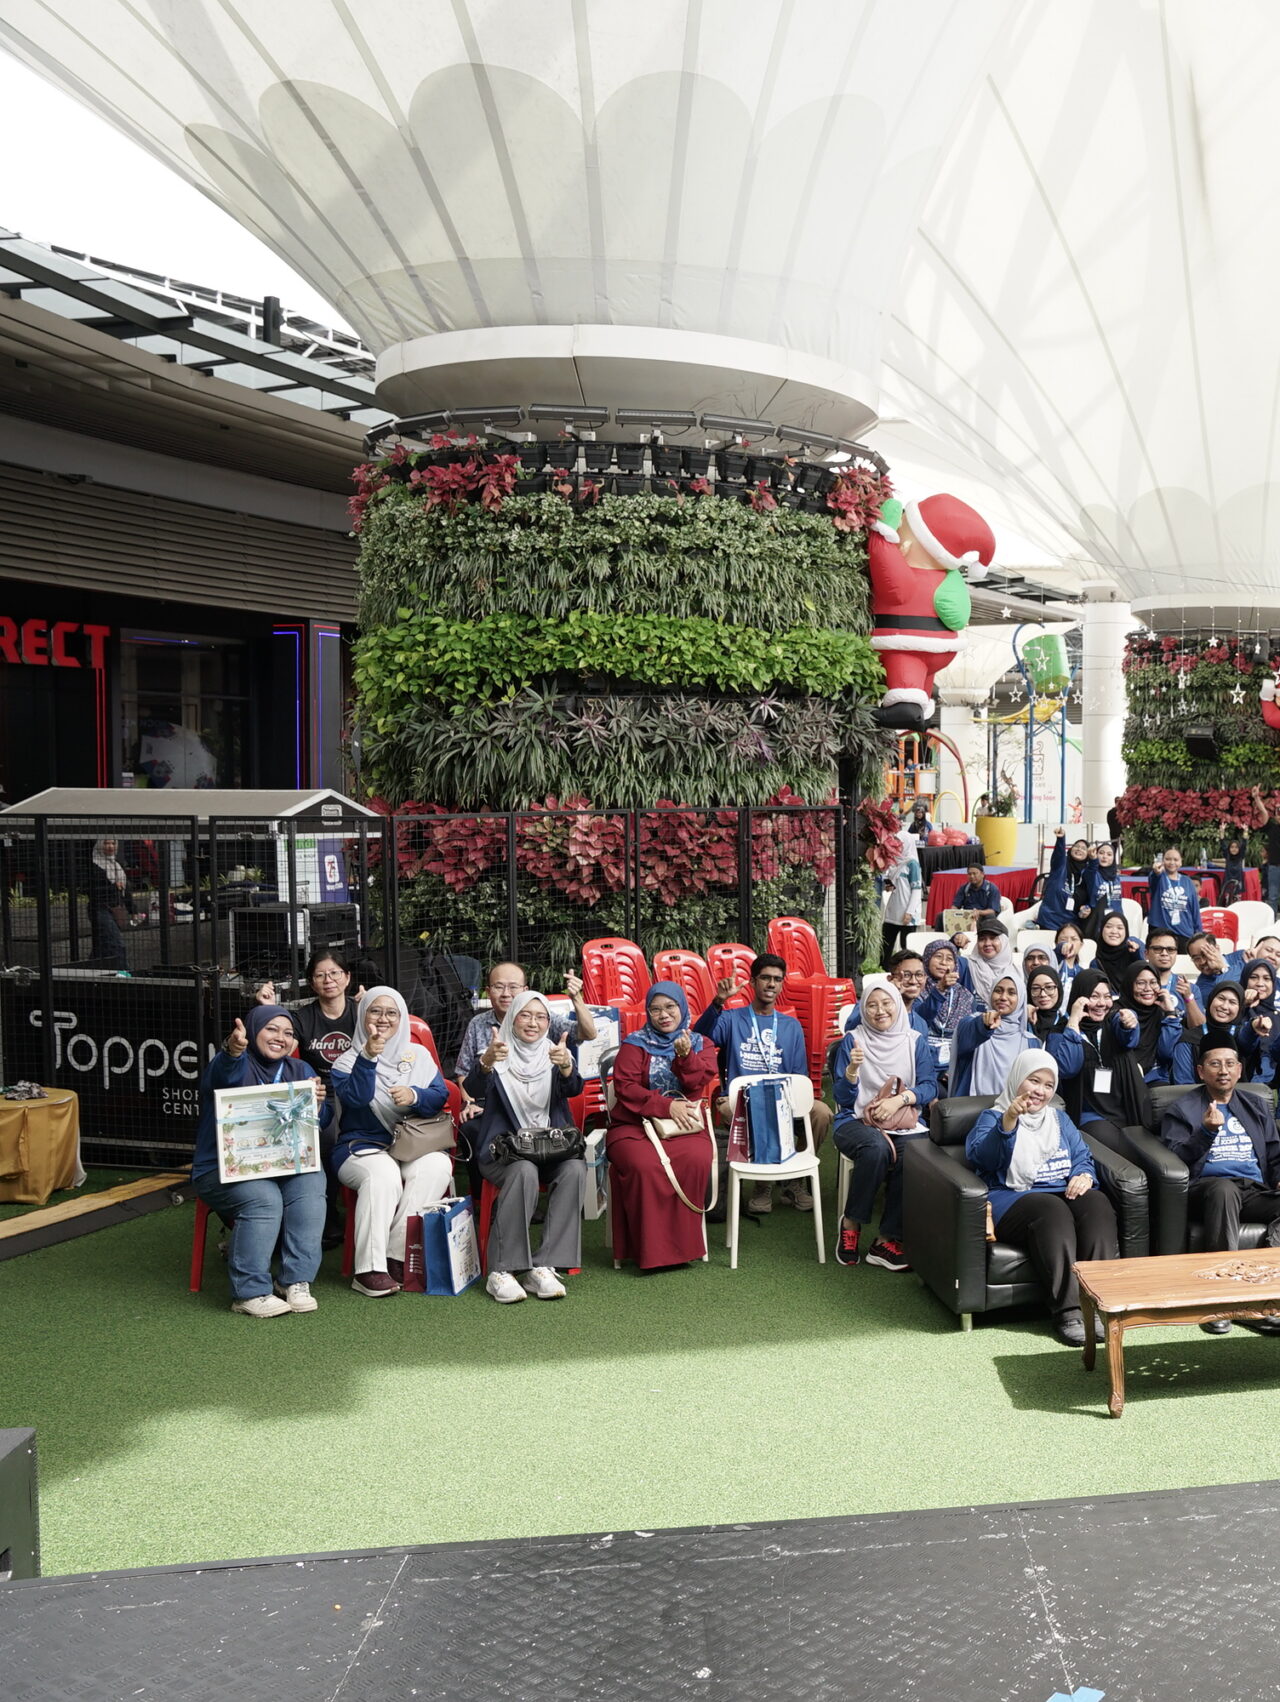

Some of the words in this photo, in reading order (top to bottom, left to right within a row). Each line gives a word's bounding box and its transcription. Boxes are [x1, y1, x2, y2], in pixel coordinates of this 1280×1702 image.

[29, 1010, 215, 1092] Toppe
[309, 1038, 336, 1050] Hard
[338, 1038, 351, 1051] Ro
[163, 1102, 199, 1116] CENT
